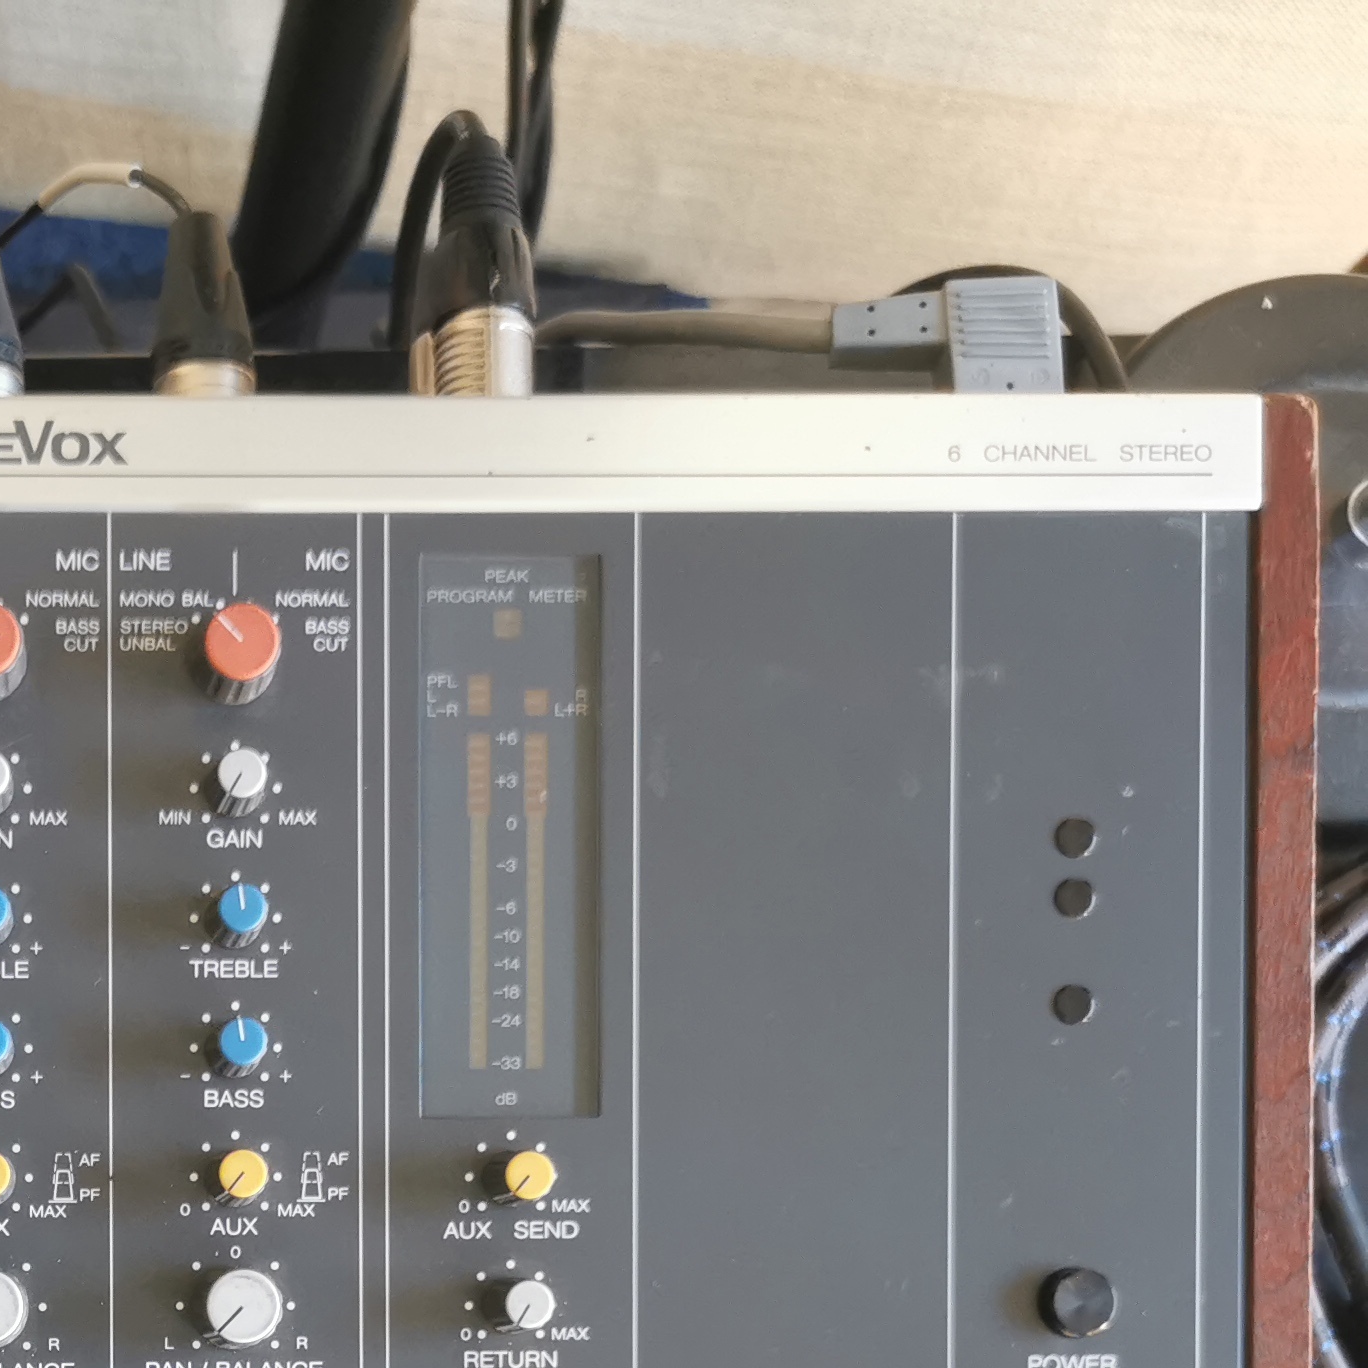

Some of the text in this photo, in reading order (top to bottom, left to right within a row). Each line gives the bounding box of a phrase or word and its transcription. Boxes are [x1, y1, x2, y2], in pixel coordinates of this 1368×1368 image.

[948, 444, 1212, 462] 6 CHANNEL STEREO
[56, 550, 99, 571] MIC
[120, 550, 170, 571] LINE
[306, 550, 349, 571] MIC
[485, 569, 530, 583] PEAK
[26, 591, 99, 607] NORMAL
[120, 591, 212, 607] MONO BAL
[276, 590, 350, 607] NORMAL
[427, 588, 587, 603] PROGRAM METER
[121, 618, 188, 634] STEREO
[306, 618, 350, 634] BASS
[120, 636, 175, 651] UNBAL
[315, 637, 348, 651] CUT
[427, 674, 457, 688] PFL
[159, 810, 191, 825] MIN
[279, 810, 316, 825] MAX
[207, 829, 264, 848] GAIN
[189, 959, 278, 978] TREBLE
[204, 1089, 264, 1108] BASS
[495, 1092, 517, 1105] dB
[552, 1199, 590, 1212] MAX
[210, 1217, 258, 1235] AUX
[443, 1220, 580, 1239] AUX SEND
[551, 1327, 590, 1340] MAX
[464, 1350, 558, 1368] RETURN
